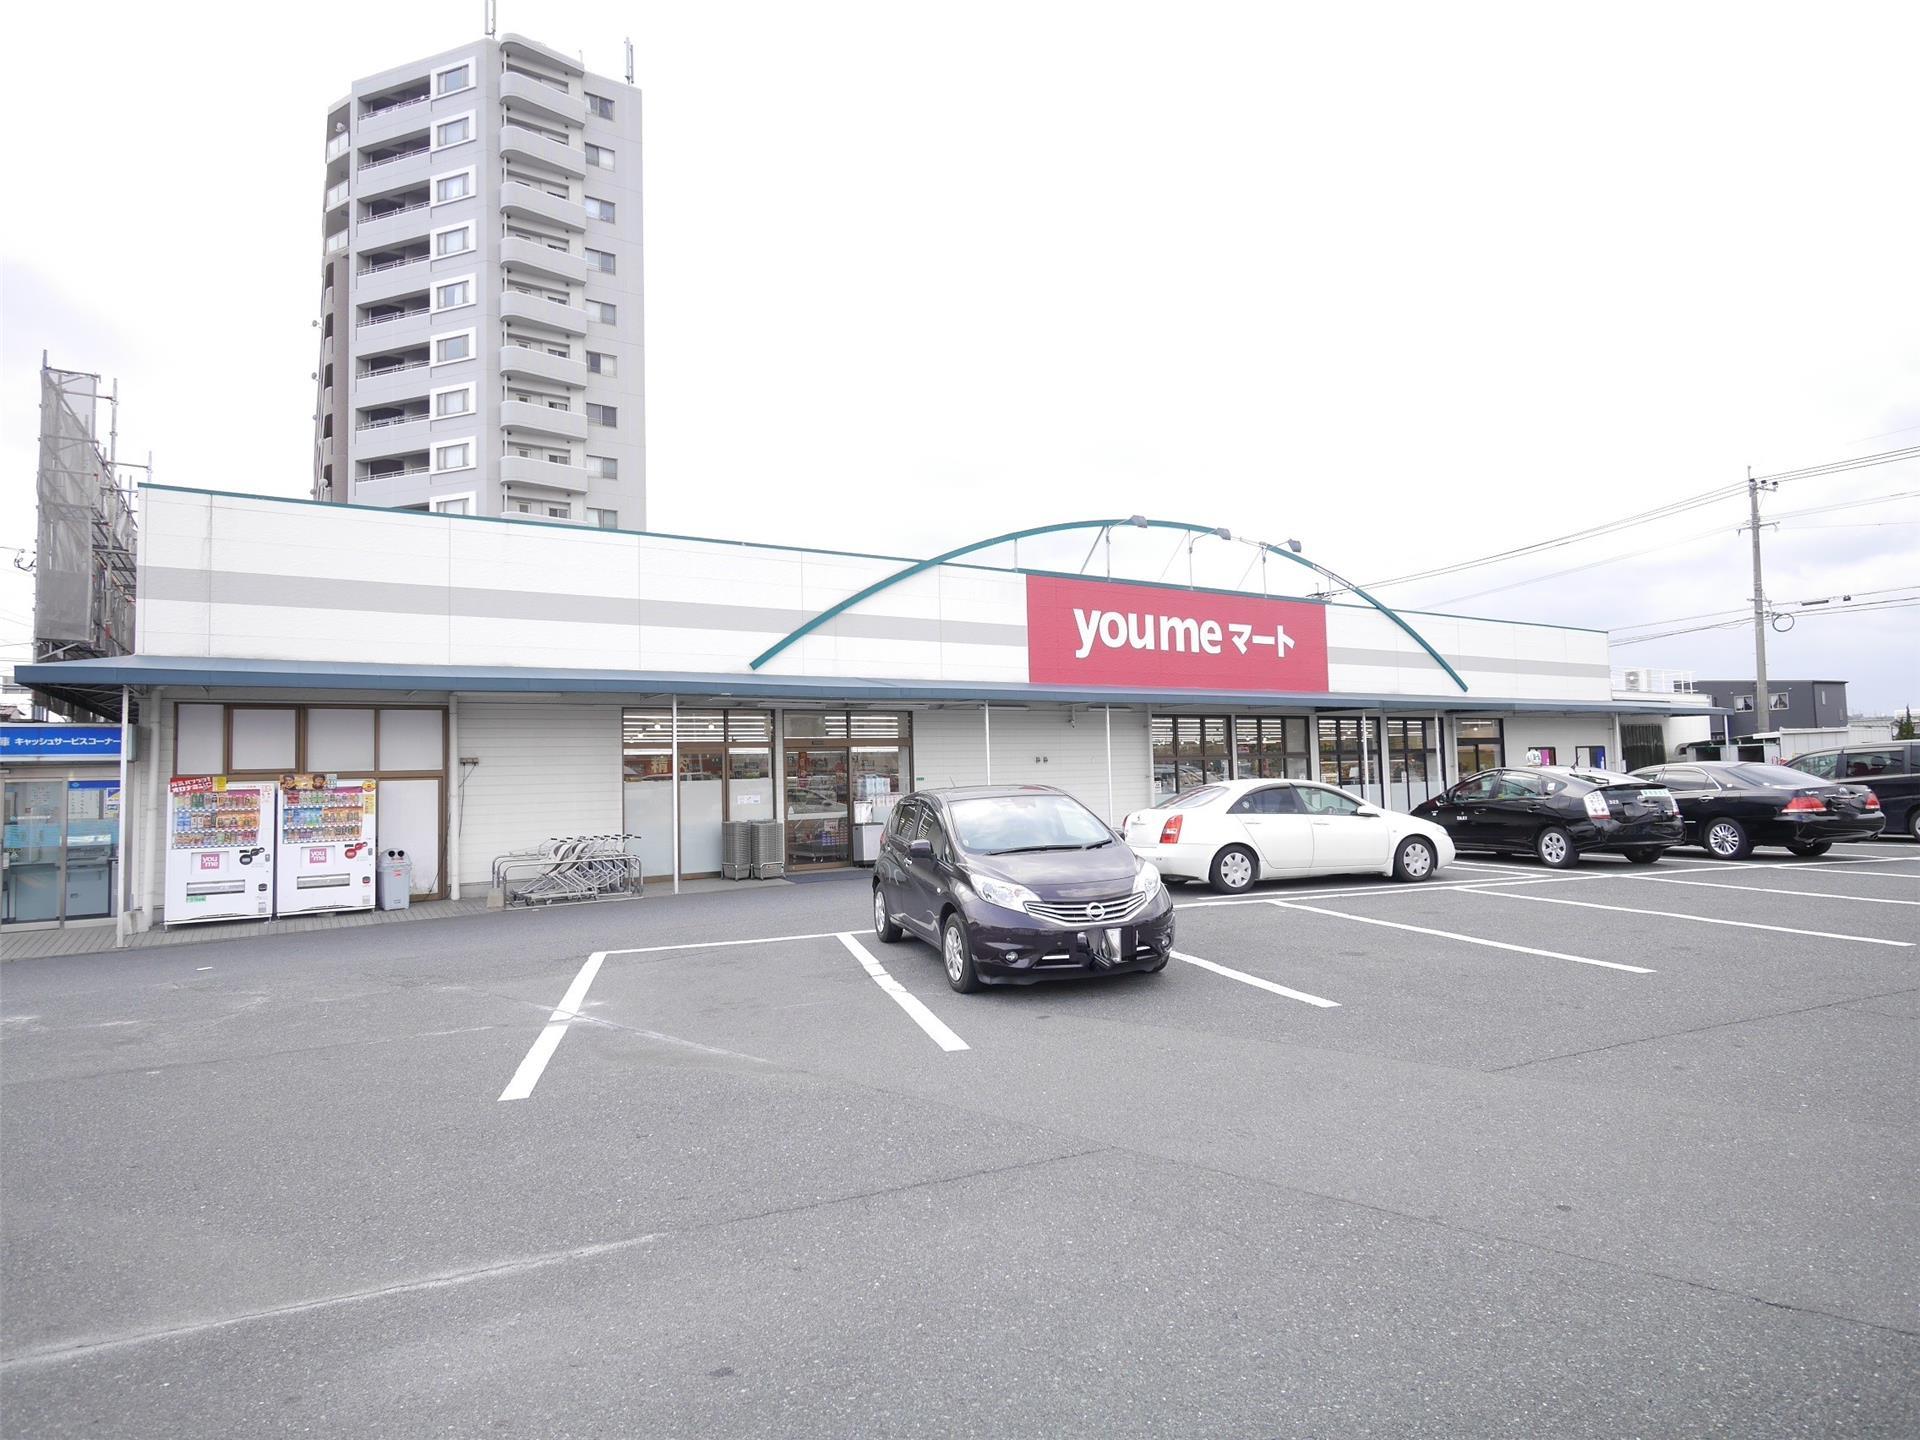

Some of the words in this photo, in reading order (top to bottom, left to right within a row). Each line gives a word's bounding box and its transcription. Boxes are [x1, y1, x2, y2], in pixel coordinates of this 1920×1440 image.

[1073, 608, 1222, 659] youme
[1228, 623, 1295, 658] マート
[15, 738, 121, 746] キャッシュサービスコーナー
